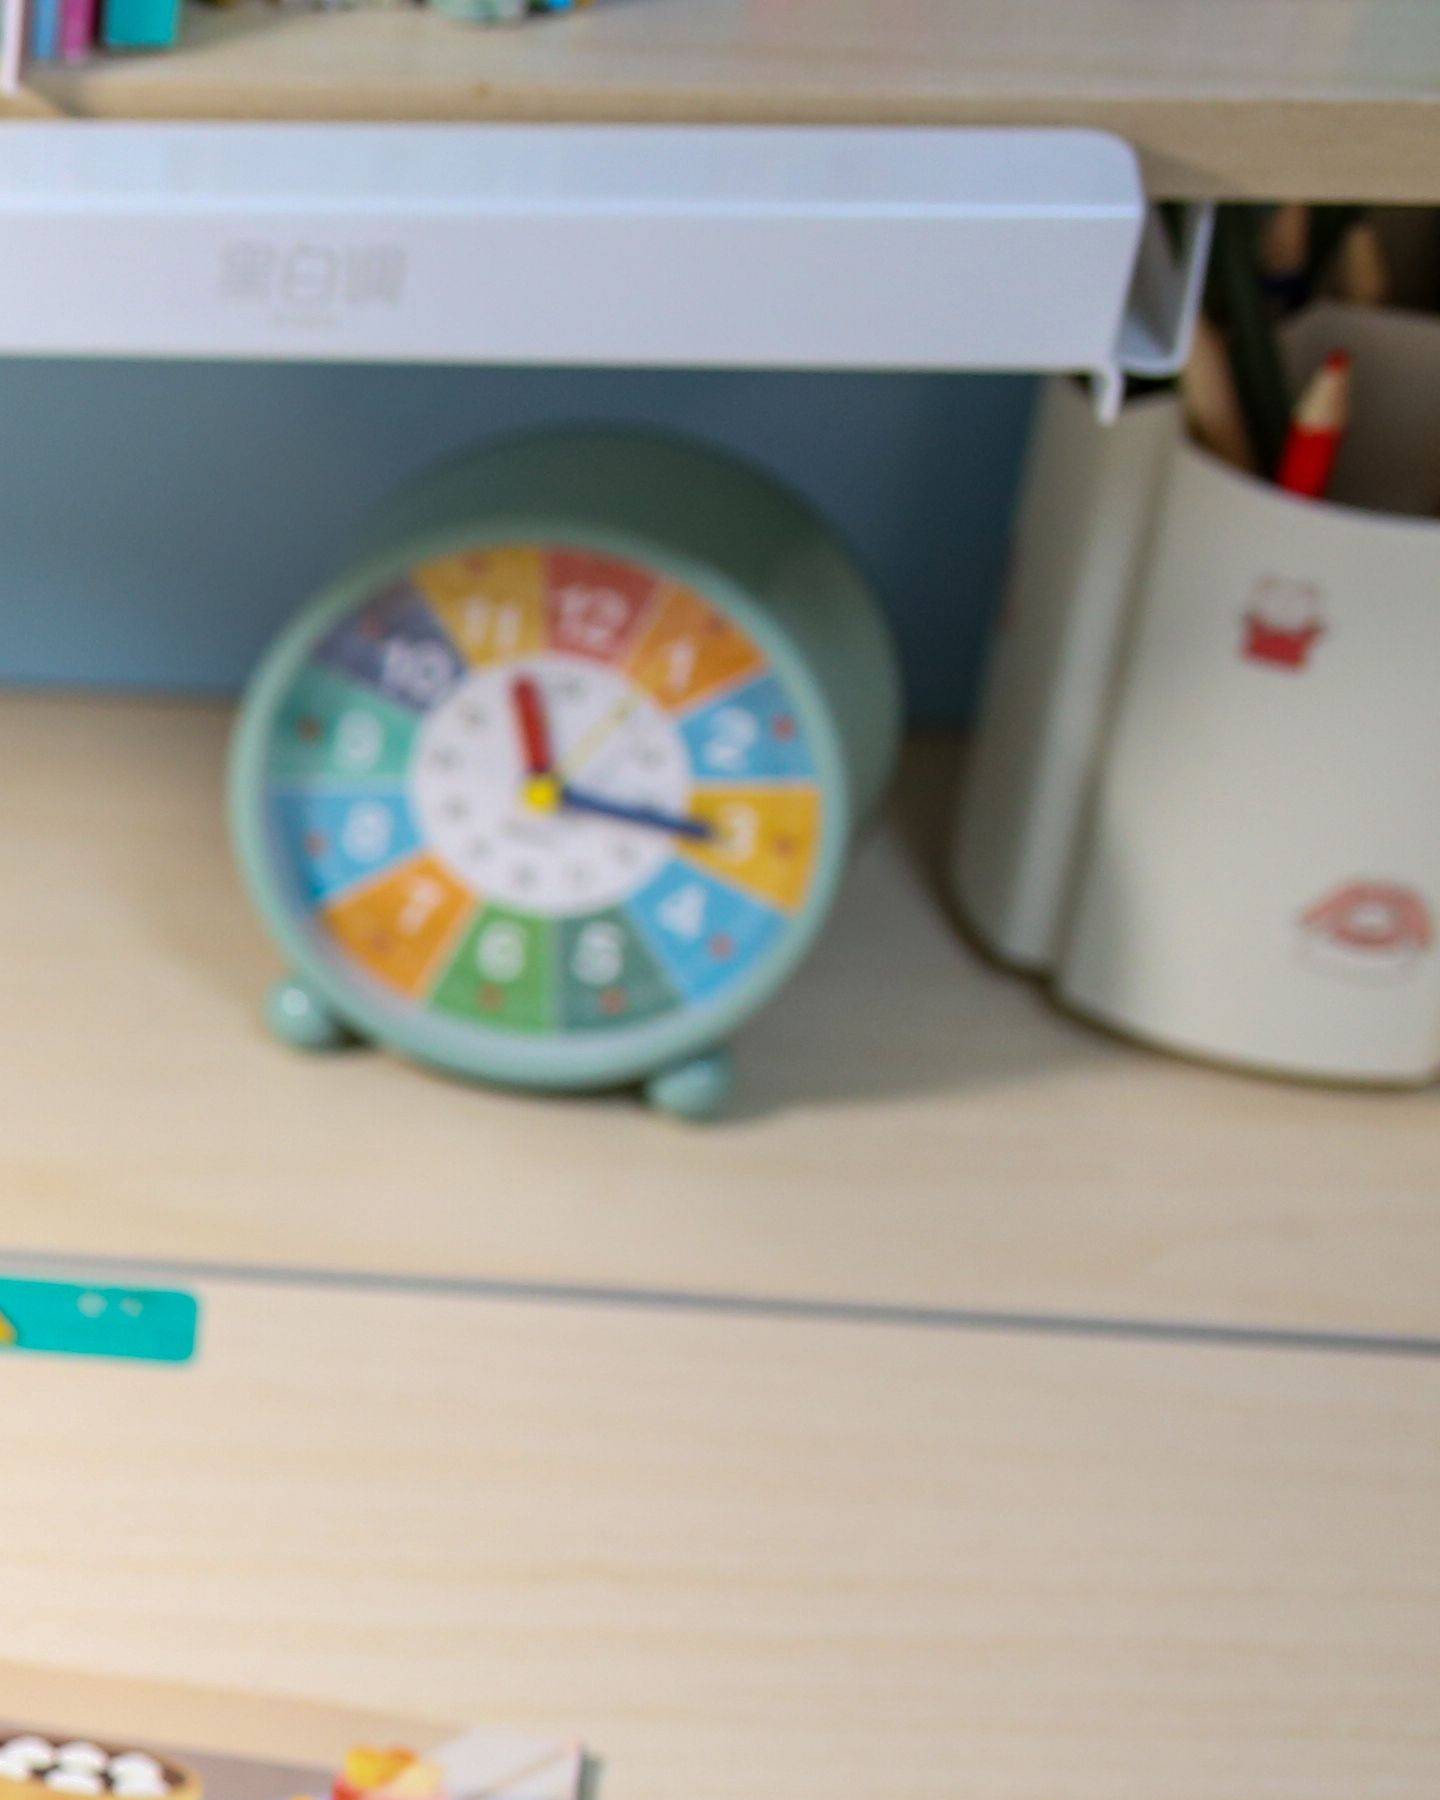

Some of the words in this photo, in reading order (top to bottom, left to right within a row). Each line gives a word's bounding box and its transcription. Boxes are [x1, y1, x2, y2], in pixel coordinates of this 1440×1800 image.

[462, 599, 521, 647] 11
[560, 585, 626, 647] 12
[379, 631, 454, 687] 10
[667, 641, 697, 688] 1
[703, 707, 757, 768] 2
[718, 805, 759, 862] 3
[397, 880, 444, 934] 7
[659, 885, 708, 939] 4
[475, 920, 524, 982] 6
